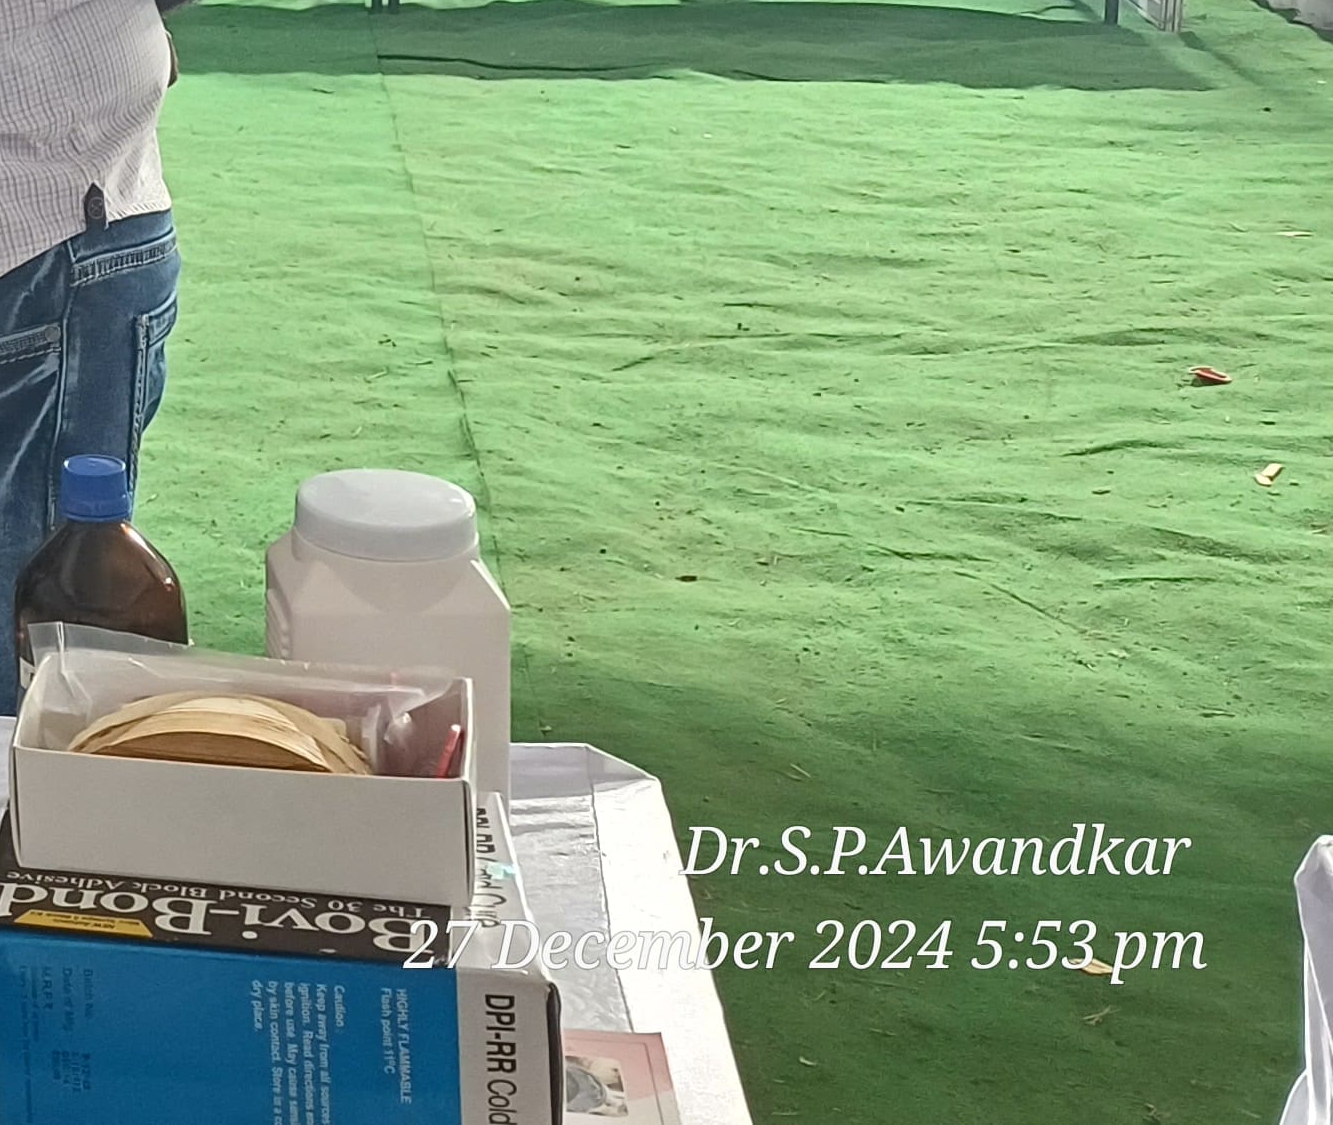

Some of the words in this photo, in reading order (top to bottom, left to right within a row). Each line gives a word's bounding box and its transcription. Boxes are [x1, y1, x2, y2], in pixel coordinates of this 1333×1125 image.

[6, 871, 126, 891] Adhesive
[134, 881, 209, 899] Block
[219, 890, 318, 910] Second
[326, 899, 363, 914] 30
[372, 904, 426, 919] The
[250, 980, 262, 998] dry
[266, 981, 277, 994] by
[284, 982, 294, 1016] before
[316, 984, 328, 1011] Keep
[381, 988, 393, 1017] Flash
[396, 989, 409, 1031] HIGHLY
[303, 1031, 314, 1057] Read
[485, 994, 516, 1073] DPI-RR
[285, 1043, 298, 1065] May
[319, 1044, 330, 1068] from
[397, 1033, 412, 1104] FLAMMABLE
[304, 1060, 315, 1110] directions
